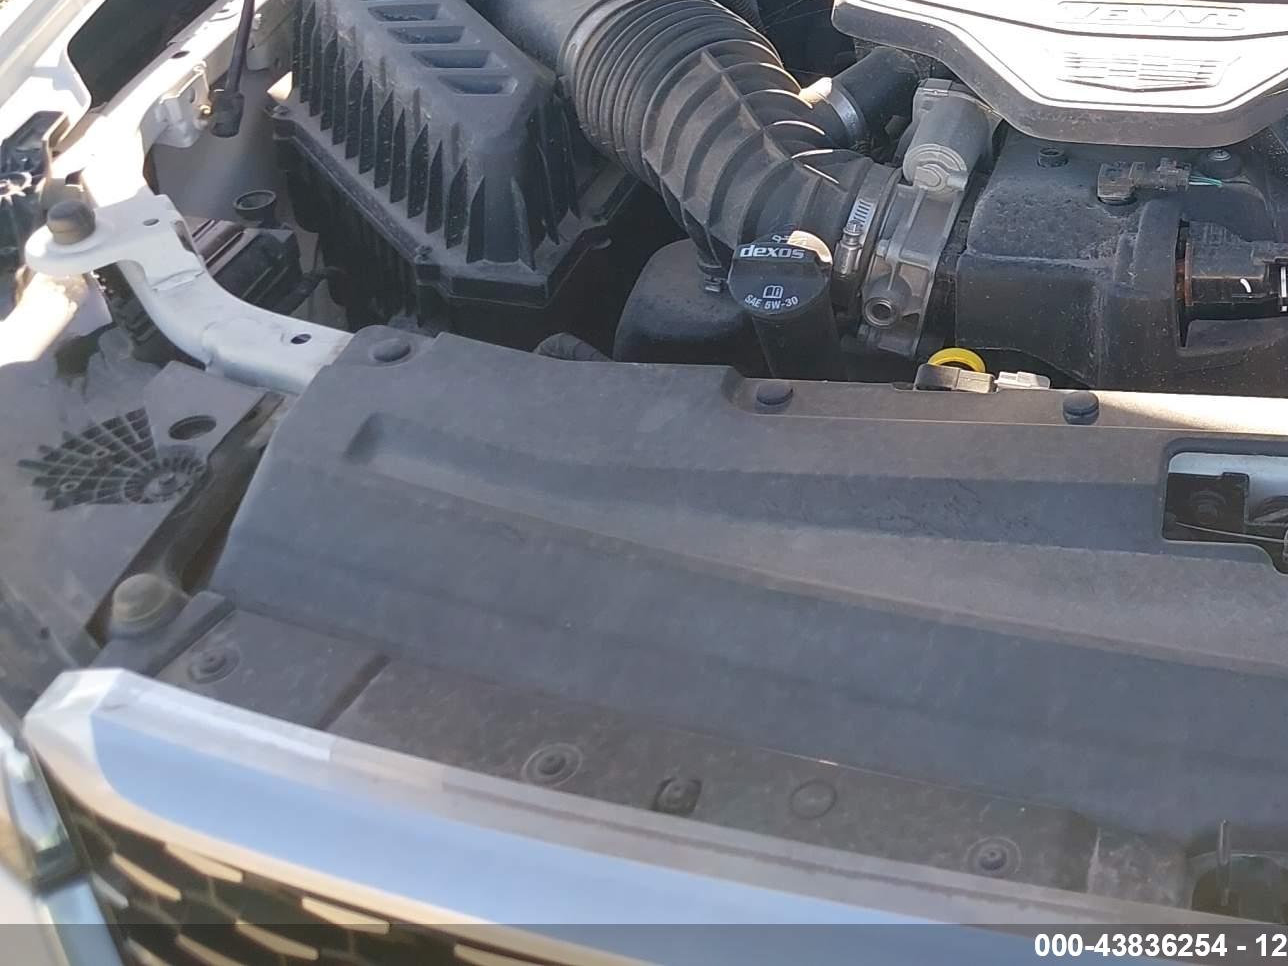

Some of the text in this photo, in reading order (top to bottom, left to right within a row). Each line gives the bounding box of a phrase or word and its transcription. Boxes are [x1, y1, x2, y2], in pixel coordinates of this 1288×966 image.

[740, 245, 805, 259] dexos
[744, 294, 798, 310] SAE 5W-30
